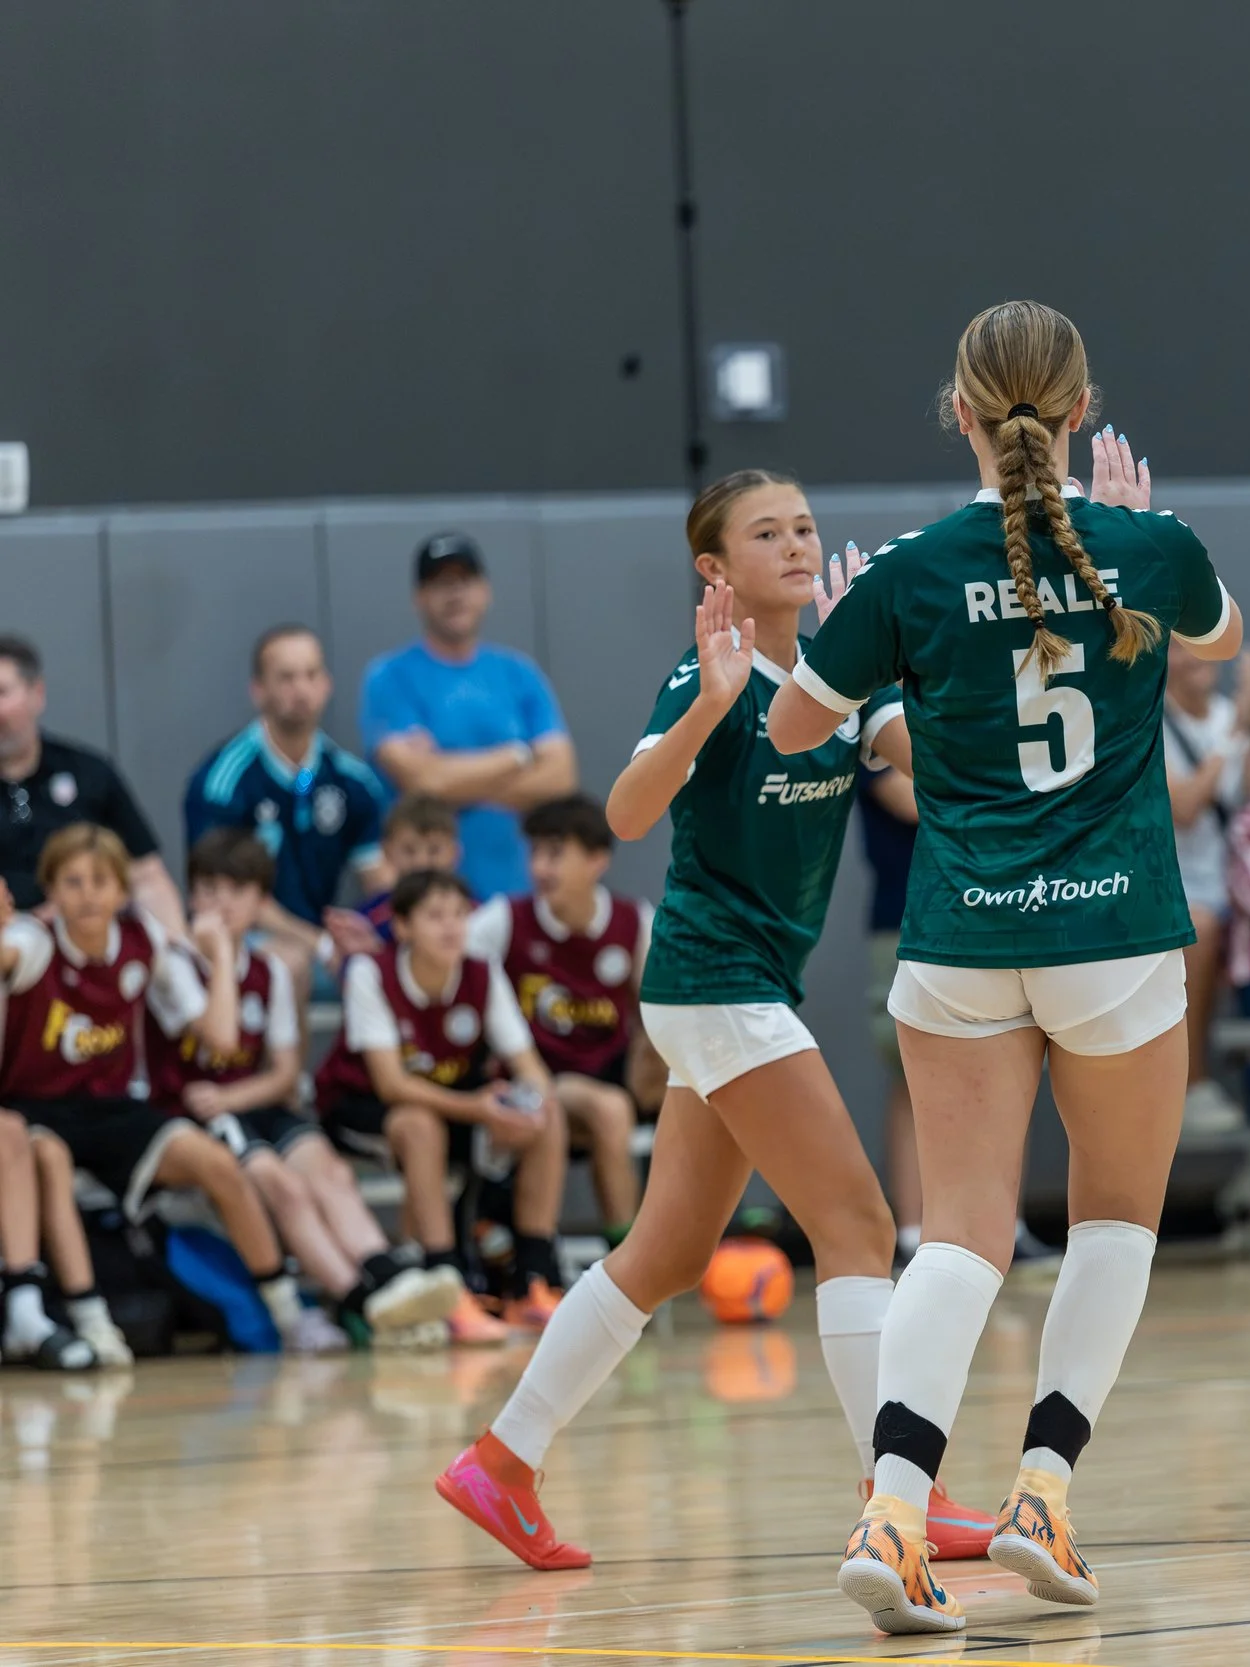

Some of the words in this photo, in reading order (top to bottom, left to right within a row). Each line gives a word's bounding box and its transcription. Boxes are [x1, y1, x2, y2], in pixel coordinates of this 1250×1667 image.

[964, 568, 1123, 623] REALE
[1012, 642, 1096, 793] 5
[962, 887, 1024, 907] Own
[1050, 871, 1129, 901] Touch
